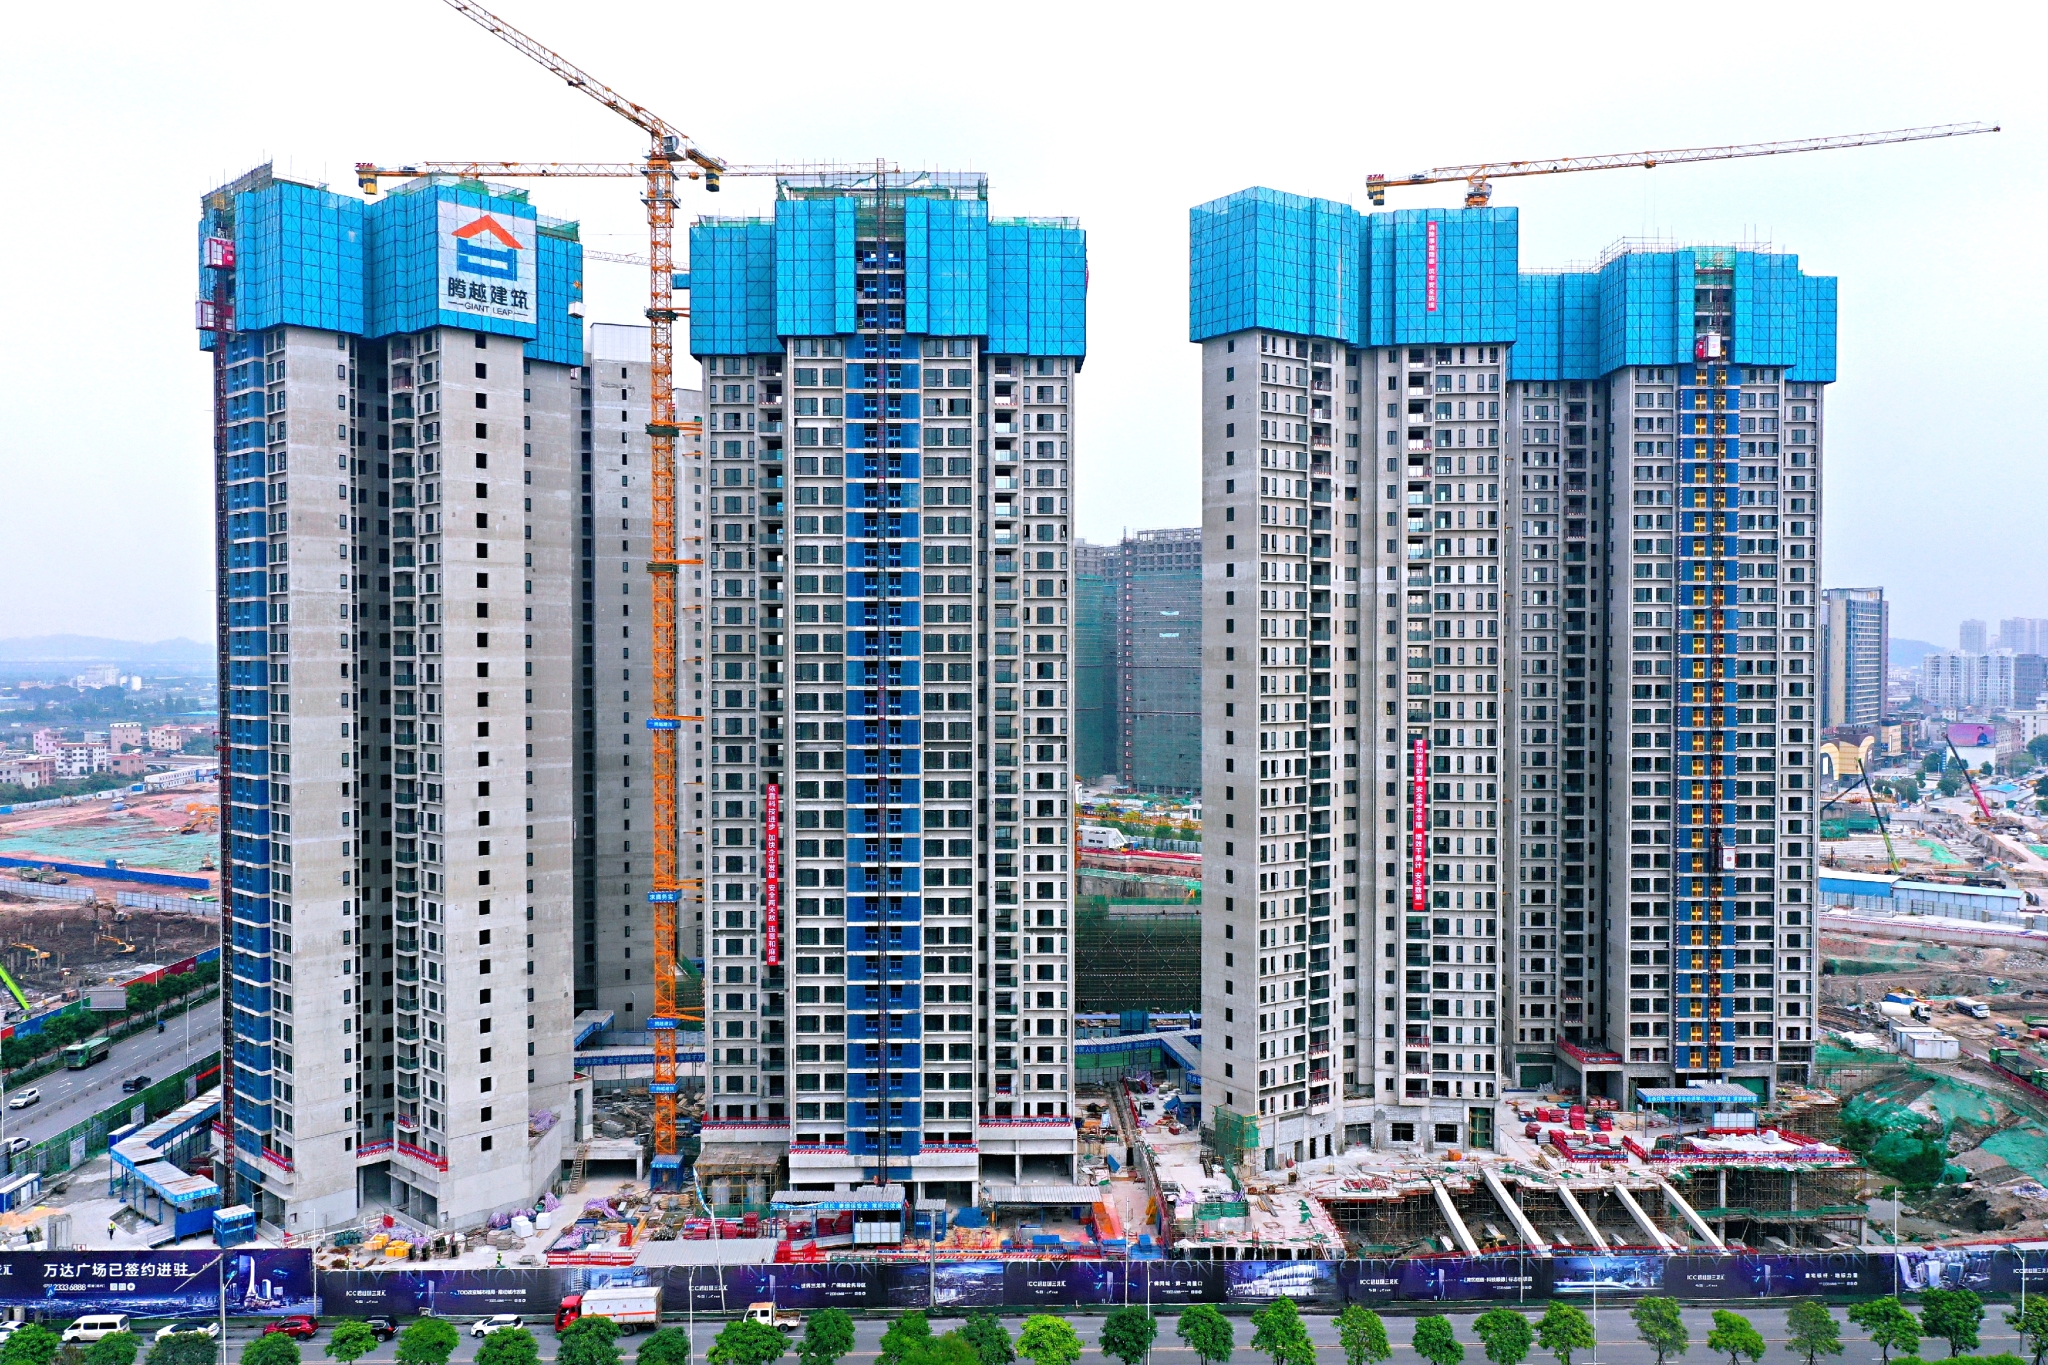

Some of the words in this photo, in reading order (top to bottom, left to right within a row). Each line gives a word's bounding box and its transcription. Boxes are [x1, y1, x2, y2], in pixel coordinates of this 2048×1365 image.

[448, 276, 528, 310] 腾越建筑
[464, 302, 490, 313] GIANT
[492, 307, 513, 316] LEAP
[1416, 740, 1424, 782] 劳动创造财富
[768, 785, 776, 830] 依靠科技进步
[1415, 786, 1423, 828] 安全带来幸福
[768, 834, 776, 879] 加快企业发展
[44, 1262, 189, 1277] 万达广场已签约进驻
